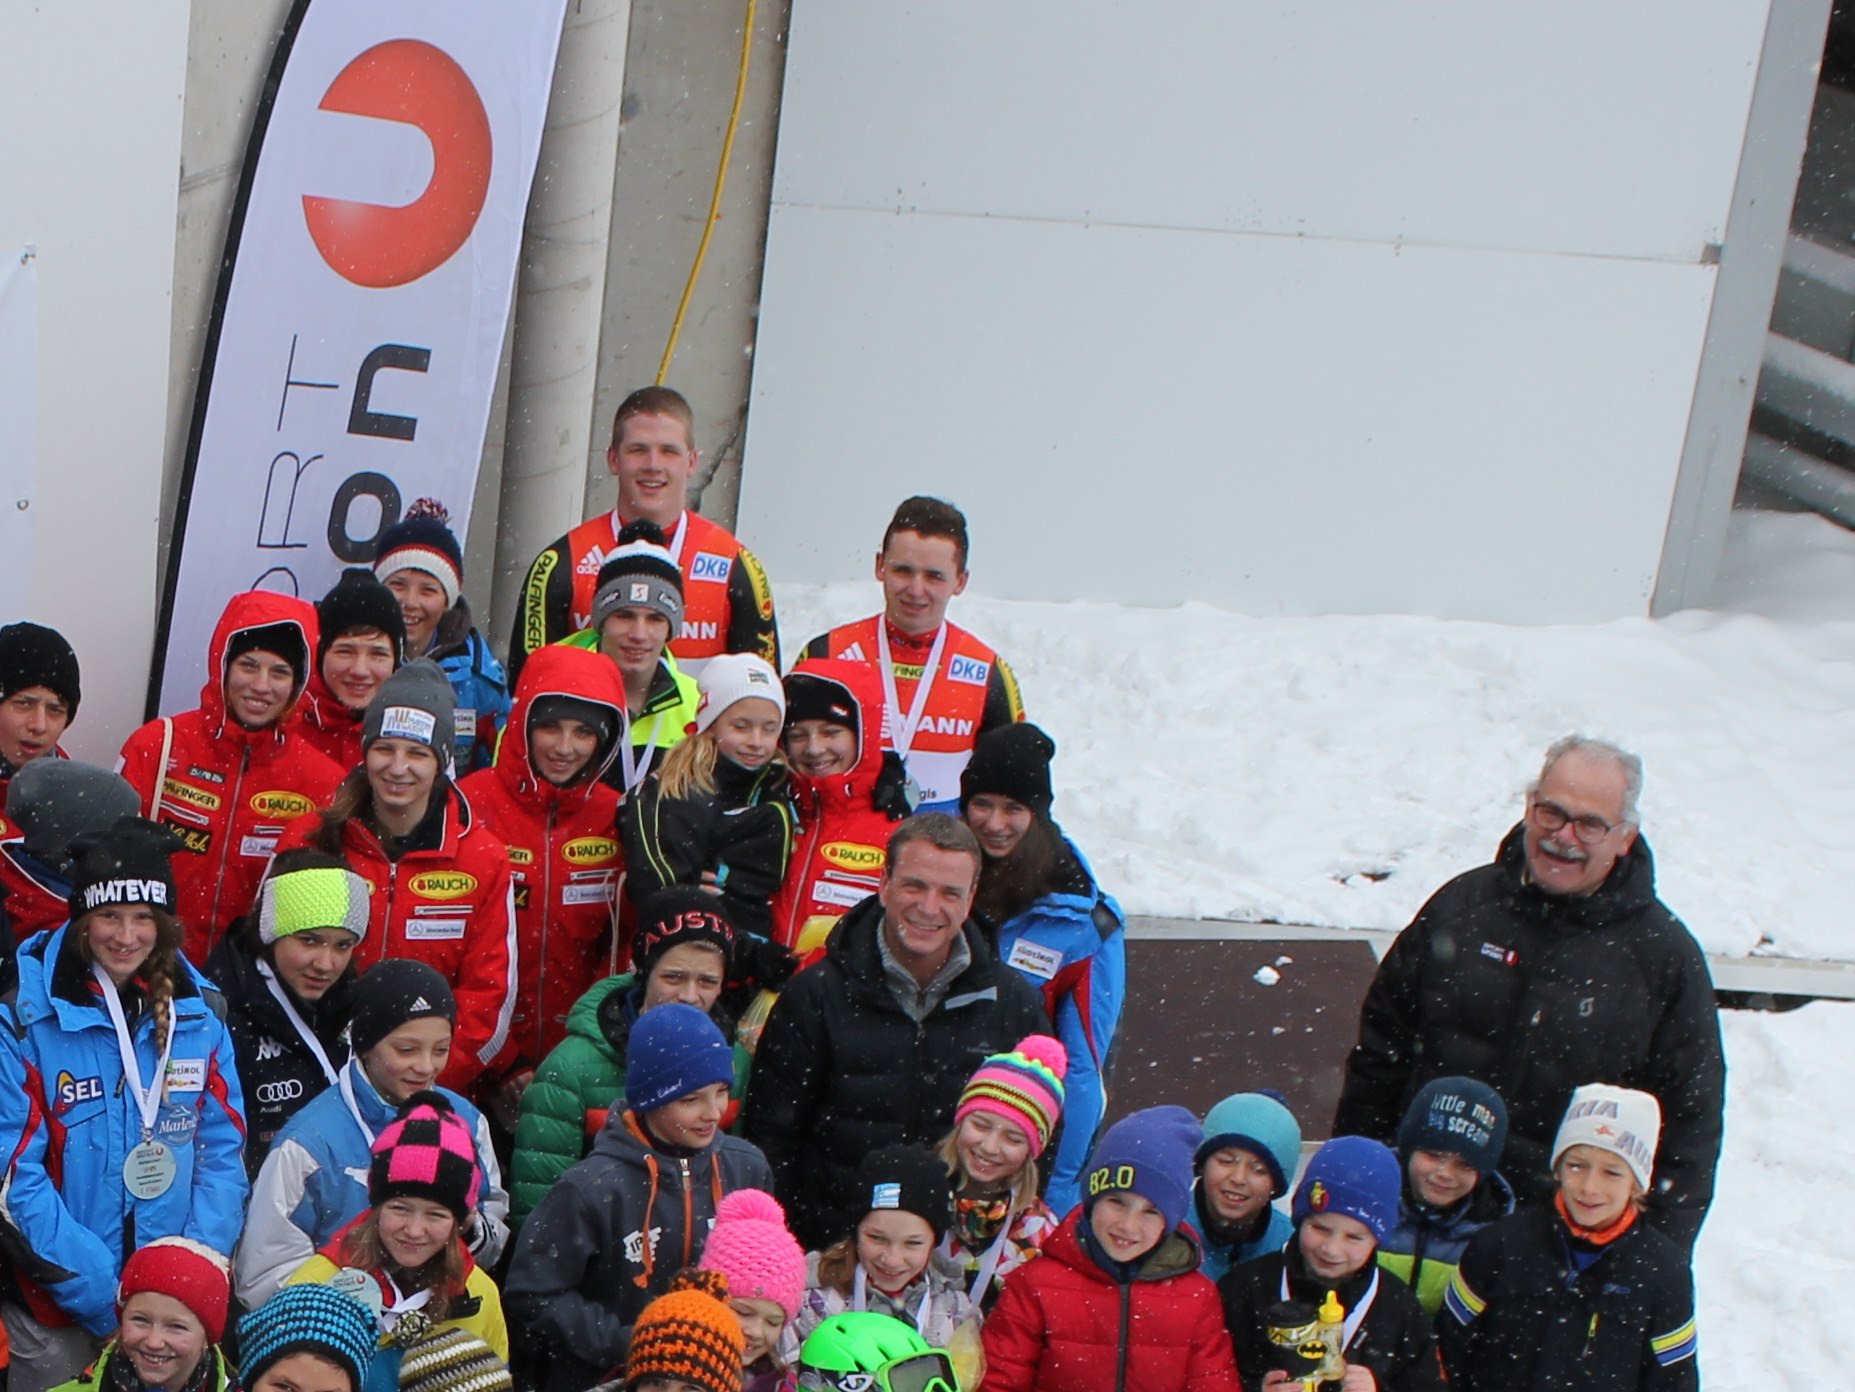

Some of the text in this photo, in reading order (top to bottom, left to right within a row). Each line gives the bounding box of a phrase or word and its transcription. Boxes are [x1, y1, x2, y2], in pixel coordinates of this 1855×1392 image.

[693, 556, 730, 579] DKB
[951, 657, 988, 681] DKB
[267, 798, 307, 813] RAUCH
[576, 844, 614, 858] RAUCH
[838, 848, 881, 864] RAUCH
[427, 877, 469, 893] RAUCH
[84, 878, 167, 909] WHATEVER
[62, 1079, 103, 1104] SEL
[260, 1104, 282, 1113] Audi
